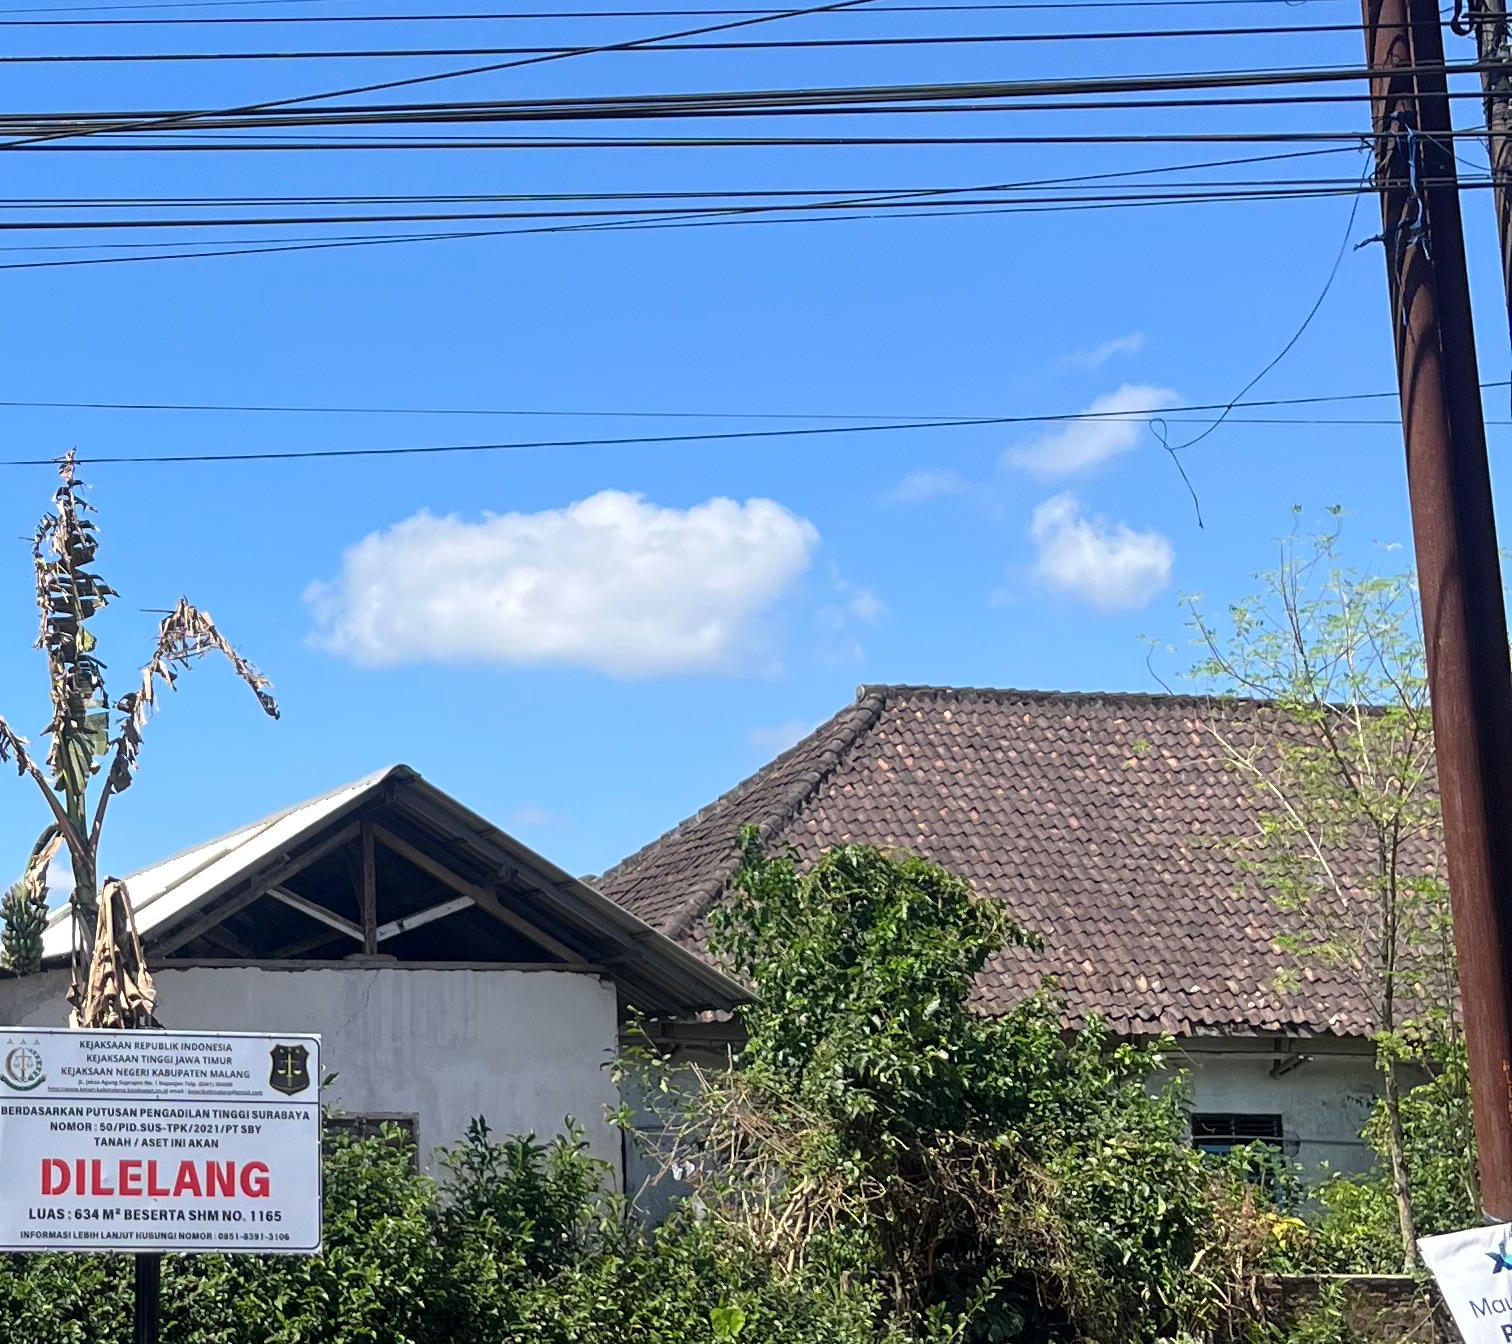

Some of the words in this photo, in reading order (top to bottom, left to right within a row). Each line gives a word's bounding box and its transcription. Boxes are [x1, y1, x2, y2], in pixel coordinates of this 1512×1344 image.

[80, 1040, 131, 1051] KEJAKSAAN
[135, 1041, 178, 1051] REPUBLIK
[181, 1042, 232, 1052] INDONESIA
[87, 1053, 138, 1065] KEJAKSAAN
[141, 1054, 173, 1064] TINGGI
[175, 1055, 200, 1066] JAWA
[203, 1055, 232, 1066] TIMUR
[61, 1066, 113, 1078] KEJAKSAAN
[116, 1067, 149, 1077] NEGERI
[152, 1068, 207, 1078] KABUPATEN
[210, 1069, 249, 1079] MALANG
[1, 1105, 83, 1117] BERDASARKAN
[86, 1106, 137, 1118] PUTUSAN
[140, 1108, 210, 1119] PENGADILAN
[212, 1109, 249, 1119] TINGGI
[252, 1110, 310, 1121] SURABAYA
[51, 1121, 91, 1132] NOMOR
[241, 1124, 261, 1134] SBY
[94, 1136, 131, 1147] TANAH
[142, 1137, 168, 1148] ASET
[171, 1138, 185, 1148] INI
[189, 1138, 218, 1149] AKAN
[41, 1158, 270, 1198] DILELANG
[29, 1207, 64, 1220] LUAS
[75, 1208, 99, 1221] 634
[124, 1208, 185, 1222] BESERTA
[189, 1209, 218, 1222] SHM
[251, 1210, 281, 1222] 1165
[21, 1230, 71, 1240] INFORMASI
[73, 1230, 98, 1240] LEBIH
[101, 1231, 134, 1240] LANJUT
[179, 1231, 212, 1241] NOMOR
